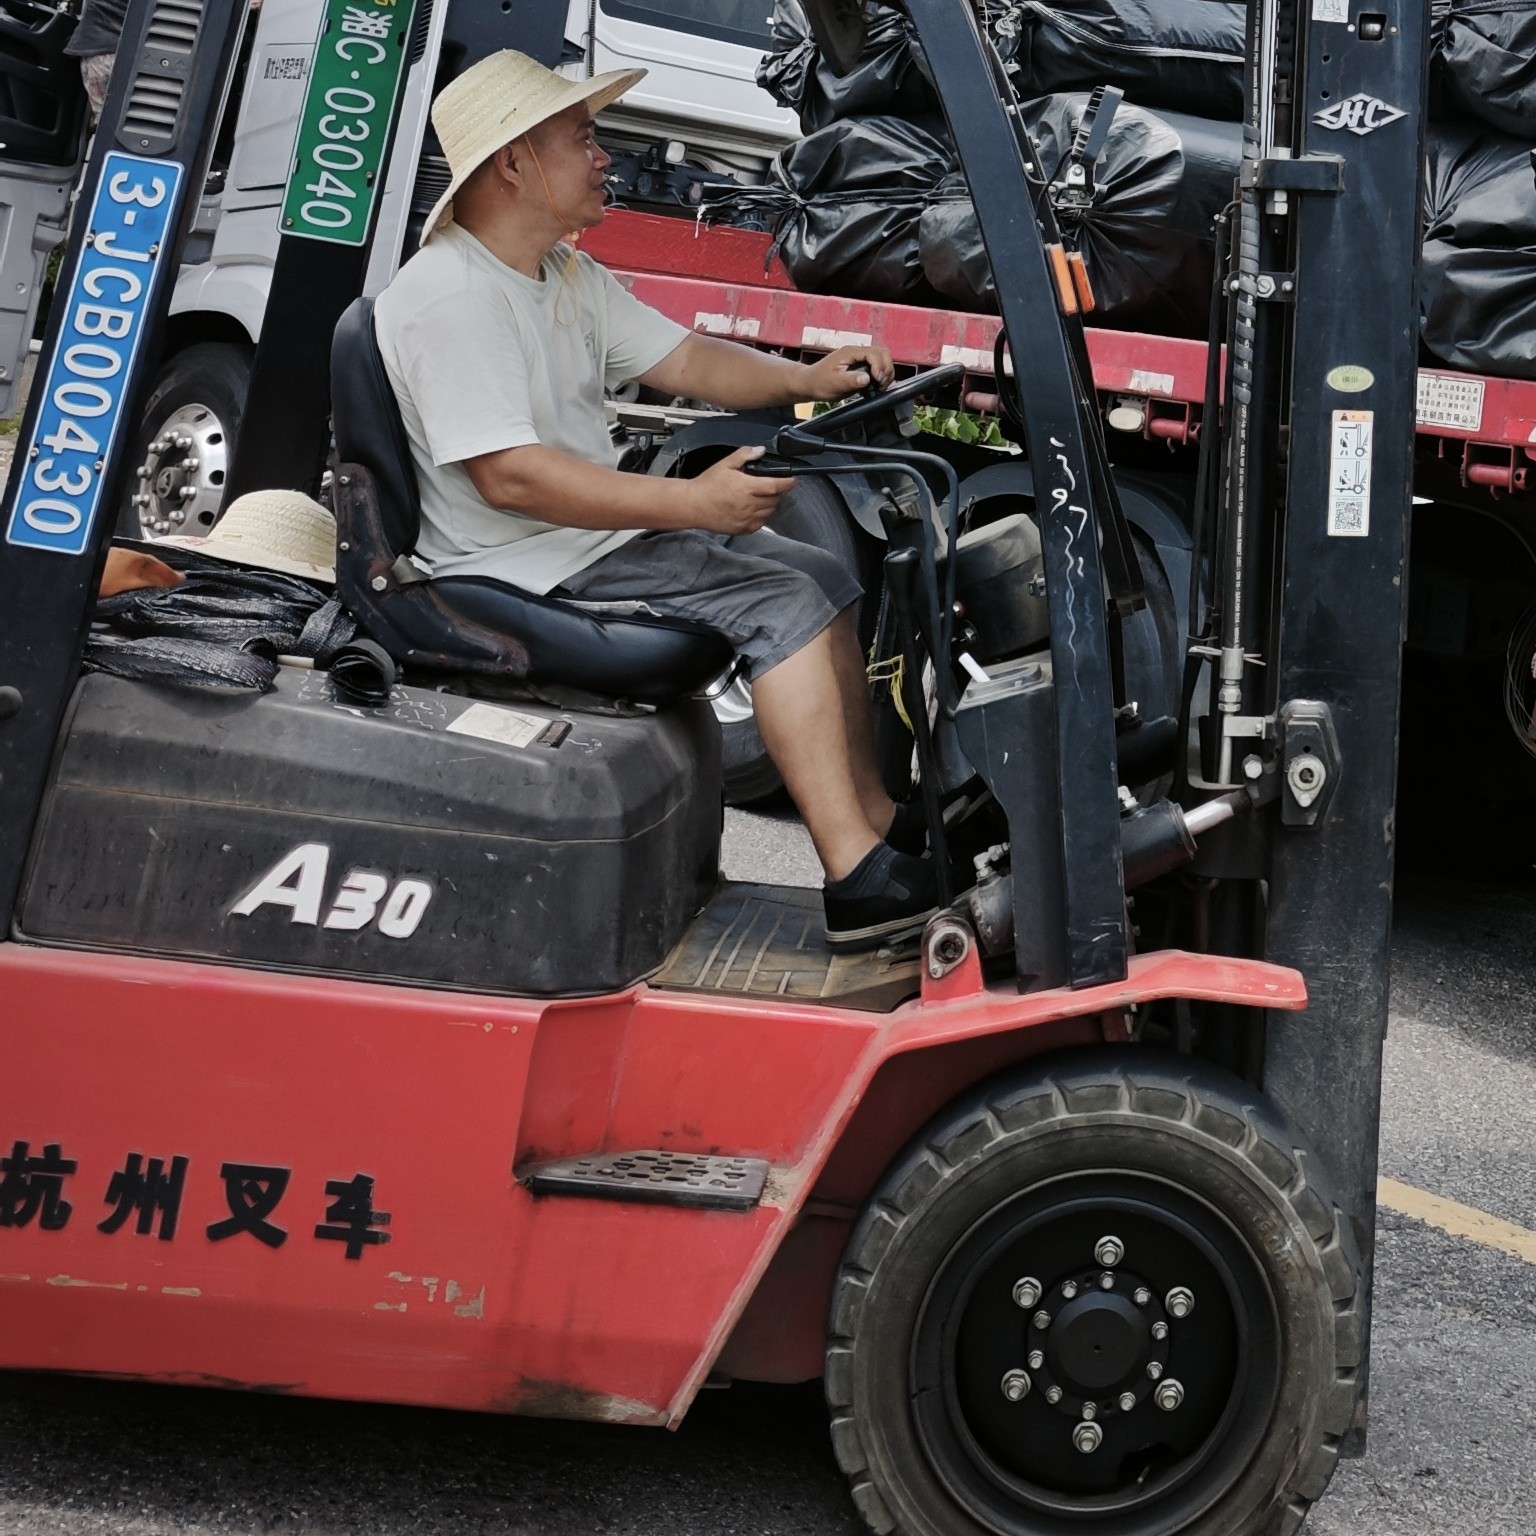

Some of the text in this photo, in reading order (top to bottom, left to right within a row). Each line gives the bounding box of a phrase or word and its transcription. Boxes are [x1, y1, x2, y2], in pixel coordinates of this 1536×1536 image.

[23, 171, 166, 535] 3-JCB00430
[227, 843, 433, 939] A30
[0, 1140, 392, 1261] 杭州叉车
